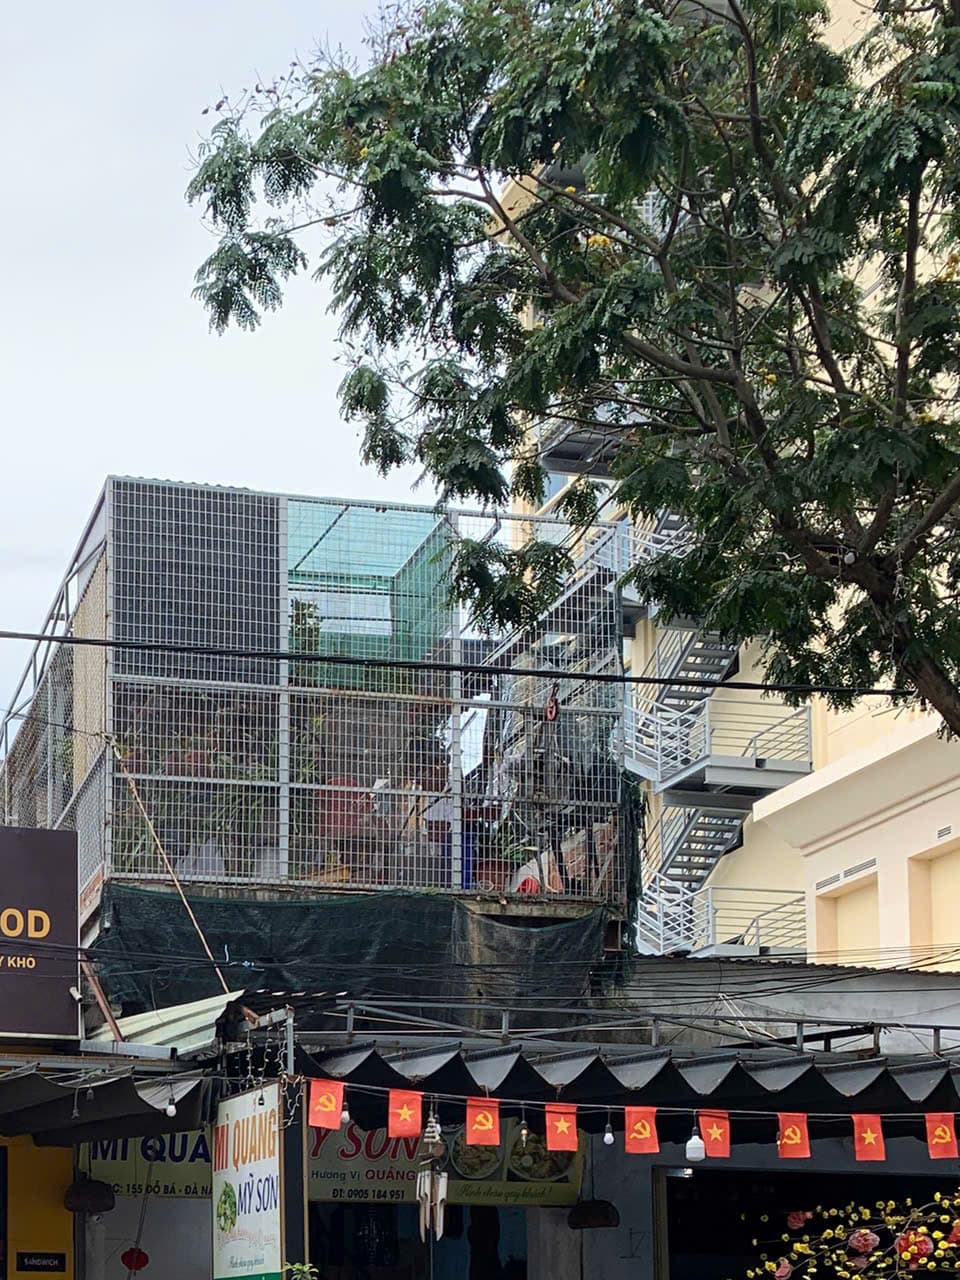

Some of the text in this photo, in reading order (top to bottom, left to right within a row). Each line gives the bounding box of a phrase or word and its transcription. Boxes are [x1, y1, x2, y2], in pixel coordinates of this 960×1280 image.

[126, 1183, 143, 1194] 155
[347, 1189, 369, 1199] 0905
[389, 1190, 405, 1199] 951
[24, 1257, 58, 1266] SANDWICH
